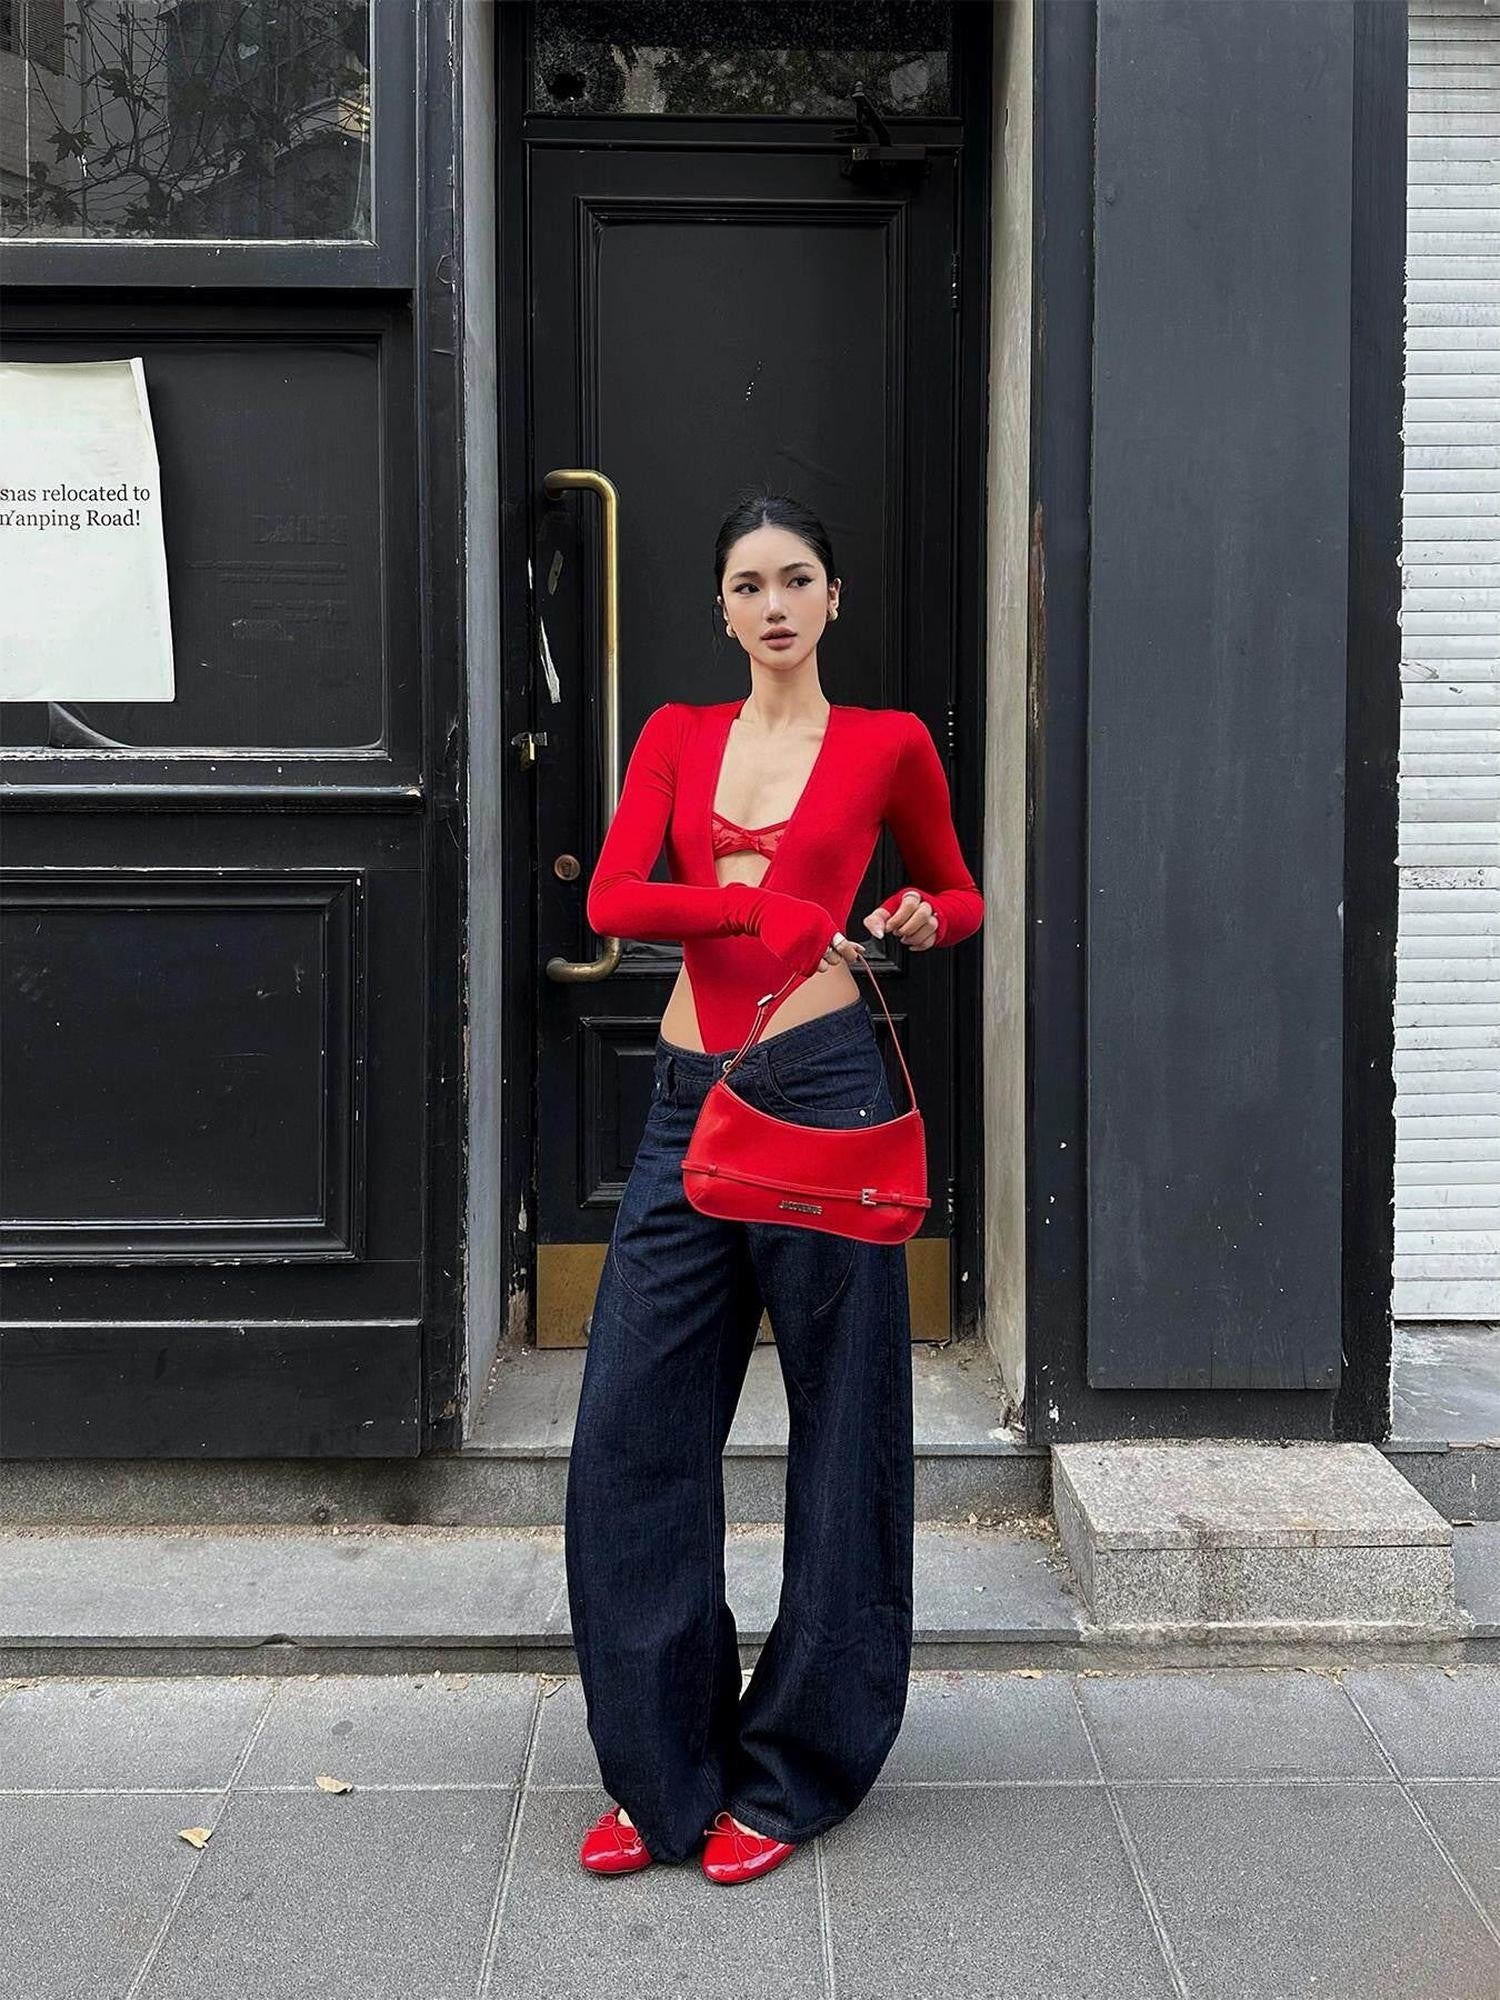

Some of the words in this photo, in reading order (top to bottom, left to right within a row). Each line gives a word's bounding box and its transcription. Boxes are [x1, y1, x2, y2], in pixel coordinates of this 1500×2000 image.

[42, 483, 128, 501] relocated
[132, 486, 151, 501] to
[86, 508, 141, 526] Road!
